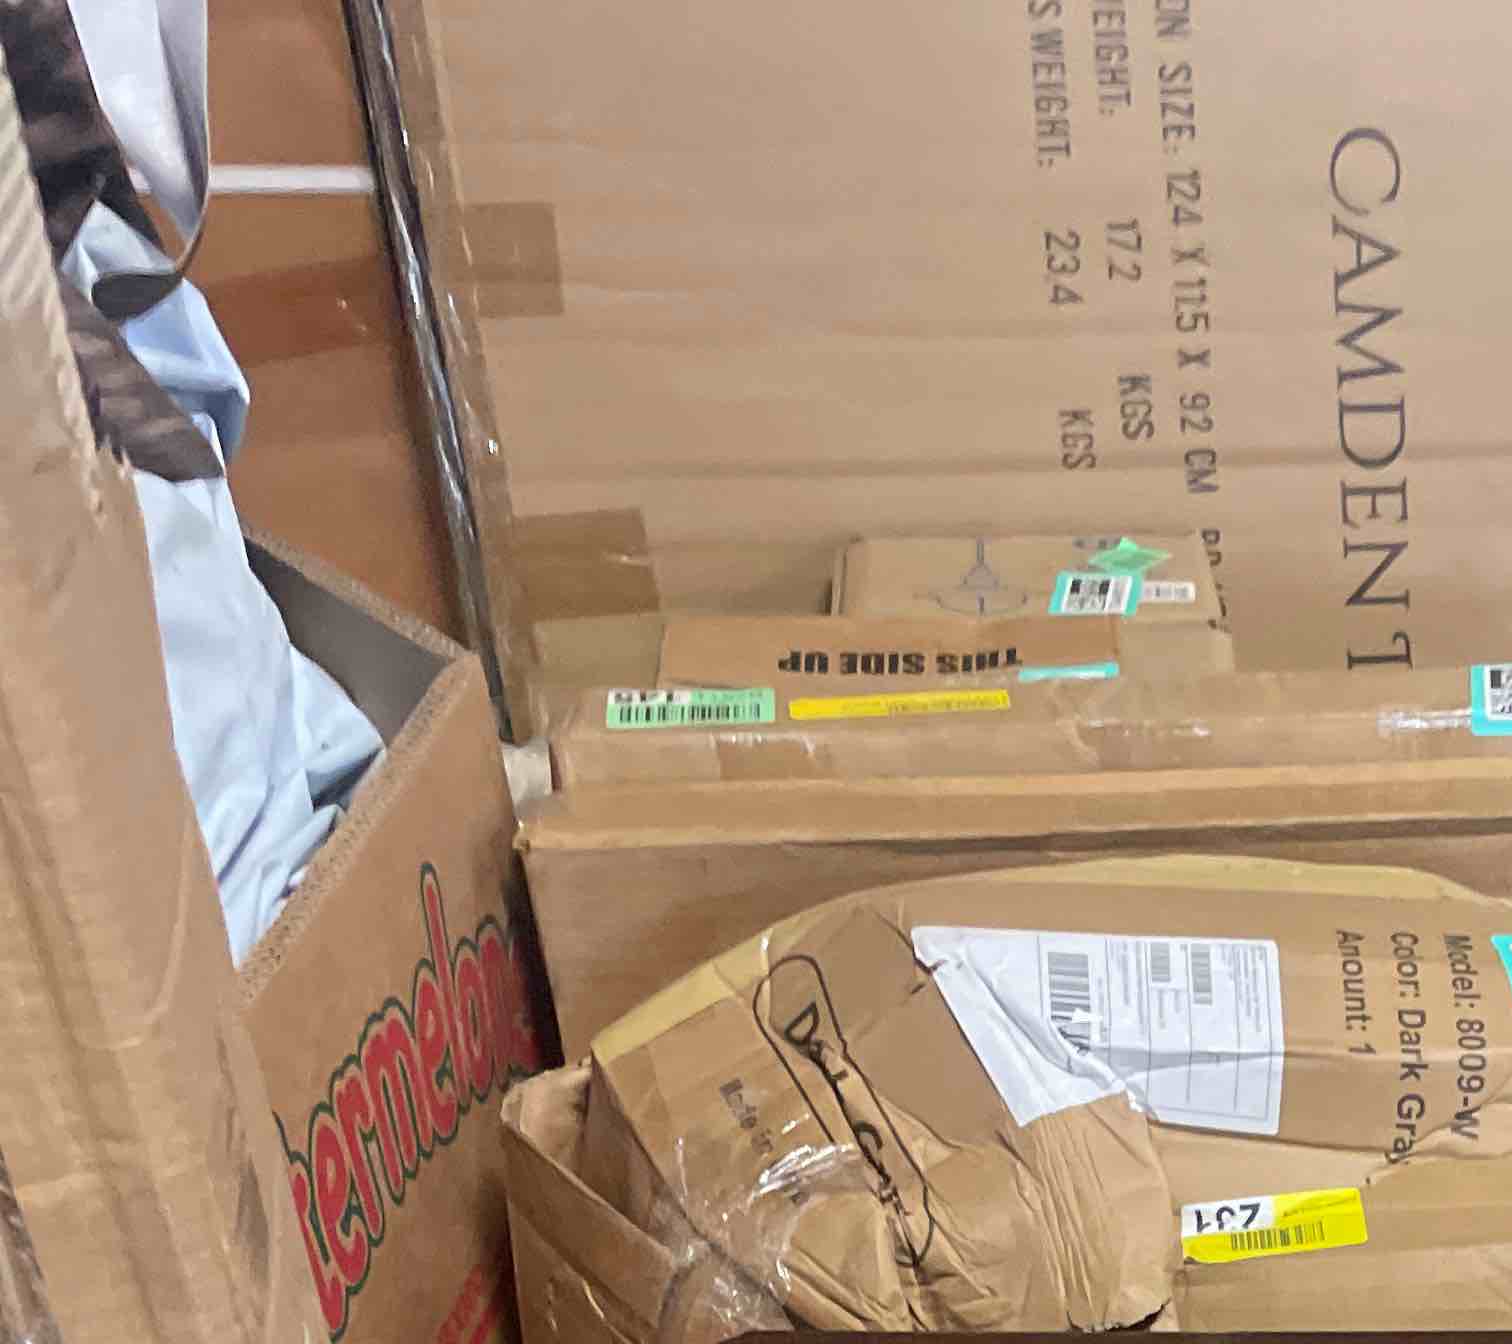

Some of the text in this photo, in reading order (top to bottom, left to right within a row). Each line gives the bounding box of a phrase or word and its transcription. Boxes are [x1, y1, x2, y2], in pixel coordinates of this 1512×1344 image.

[1159, 62, 1197, 155] SIZE:
[1030, 28, 1071, 168] WEIGHT:
[1058, 408, 1097, 471] KGS
[1093, 0, 1131, 116] EIGHT:
[1118, 374, 1155, 441] KGS
[1177, 349, 1211, 368] X
[1328, 126, 1412, 612] CAMDEN
[1180, 393, 1214, 436] 92
[1184, 447, 1221, 494] CM
[777, 650, 829, 674] UP
[840, 651, 926, 675] SIDE
[1347, 1042, 1377, 1055] 1
[1398, 1008, 1429, 1082] Dark
[1444, 933, 1487, 1141] Model: 8009-W
